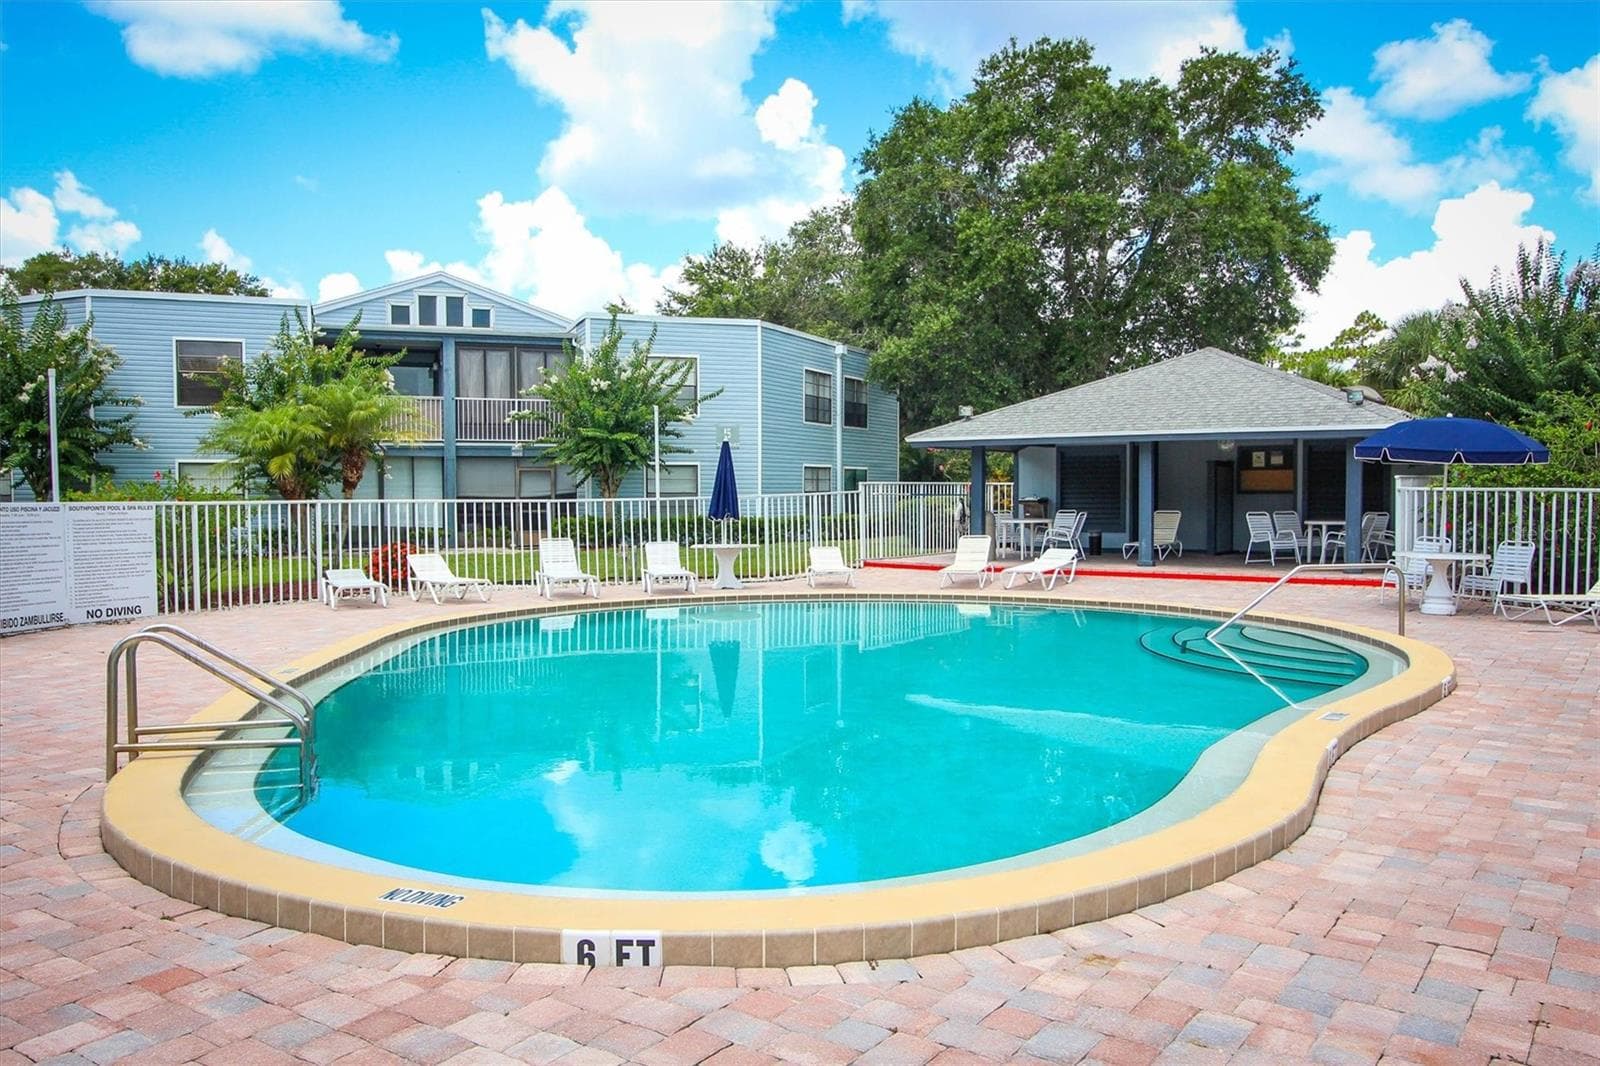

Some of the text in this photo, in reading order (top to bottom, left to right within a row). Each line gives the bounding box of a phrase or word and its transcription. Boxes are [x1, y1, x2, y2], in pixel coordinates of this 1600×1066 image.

[19, 612, 64, 627] ZAMBULLIRSE
[86, 605, 142, 619] NO DIVING
[378, 888, 465, 908] NO DIVING
[577, 939, 656, 968] 6 FT
